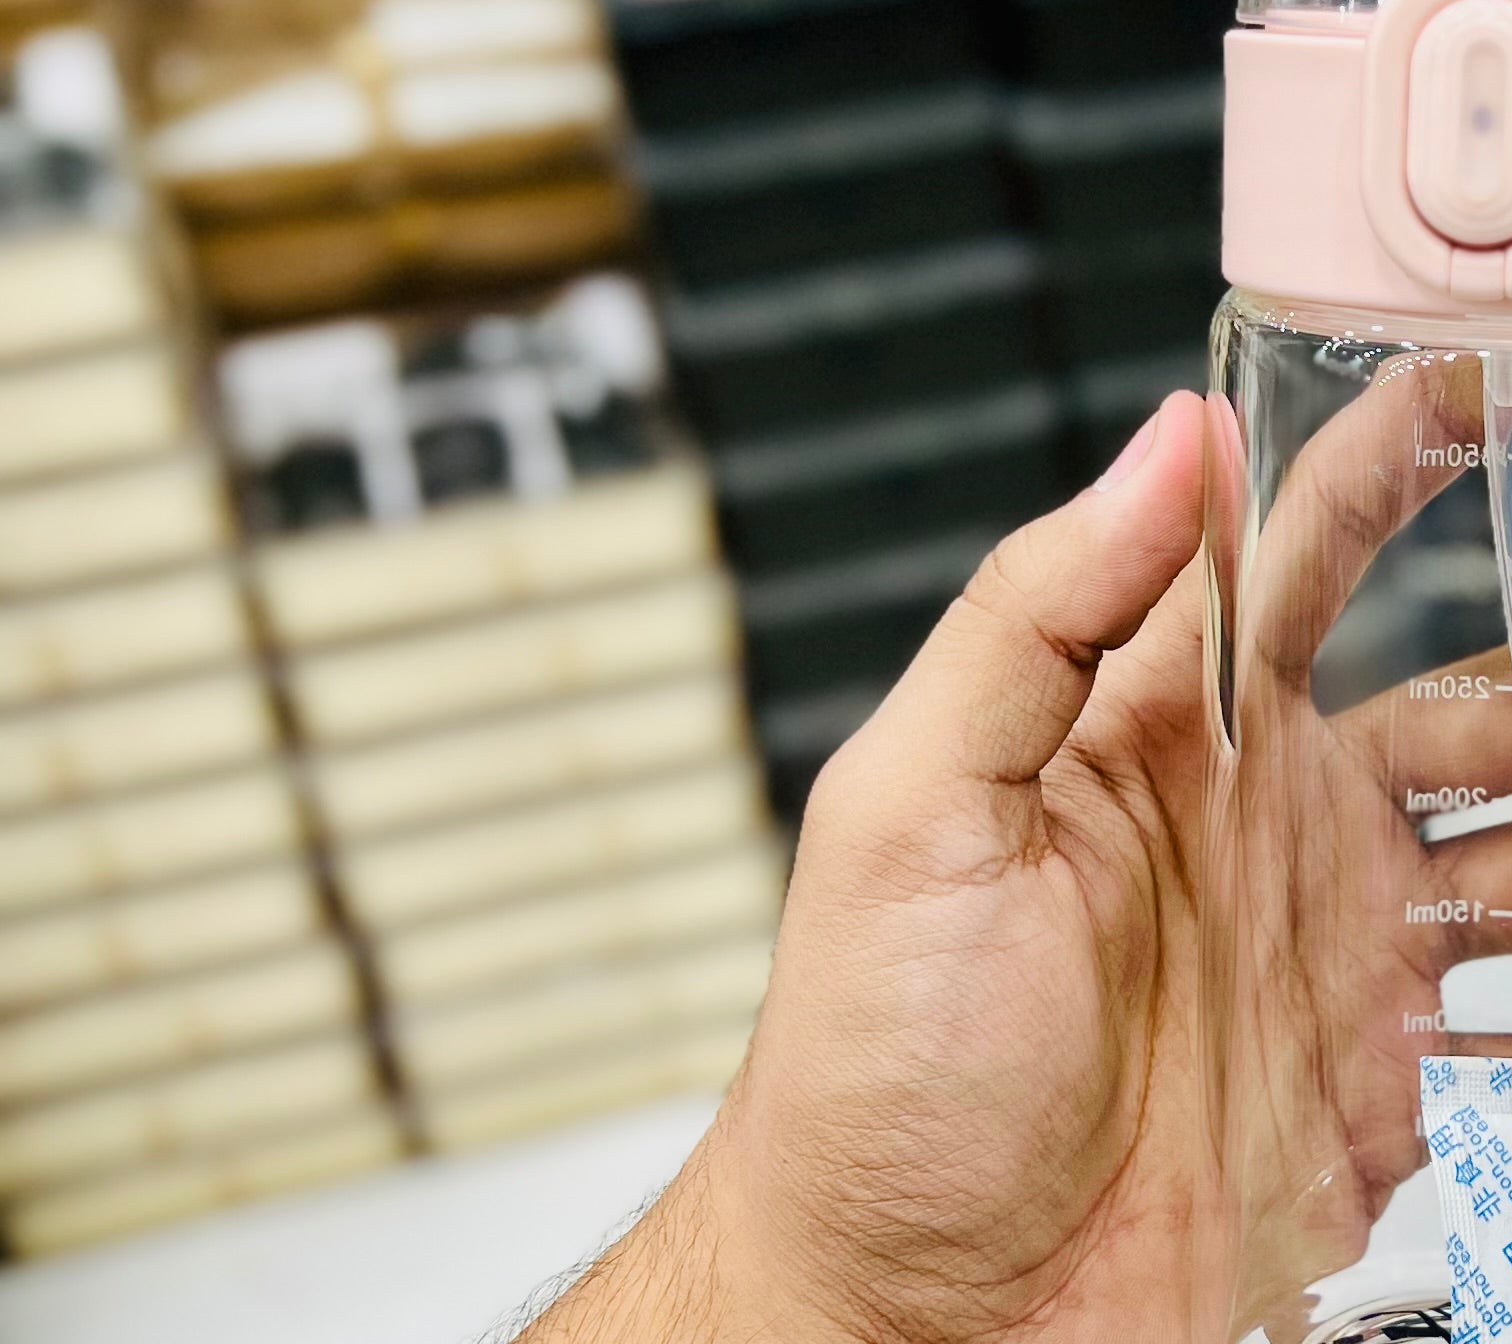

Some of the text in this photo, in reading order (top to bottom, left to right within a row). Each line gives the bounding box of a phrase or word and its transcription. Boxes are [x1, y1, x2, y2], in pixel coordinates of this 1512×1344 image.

[1461, 1103, 1488, 1132] eat
[1487, 1135, 1512, 1165] not
[1428, 1124, 1501, 1222] 非食用
[1446, 1242, 1502, 1337] non-foo
[1448, 1231, 1512, 1326] do not eat
